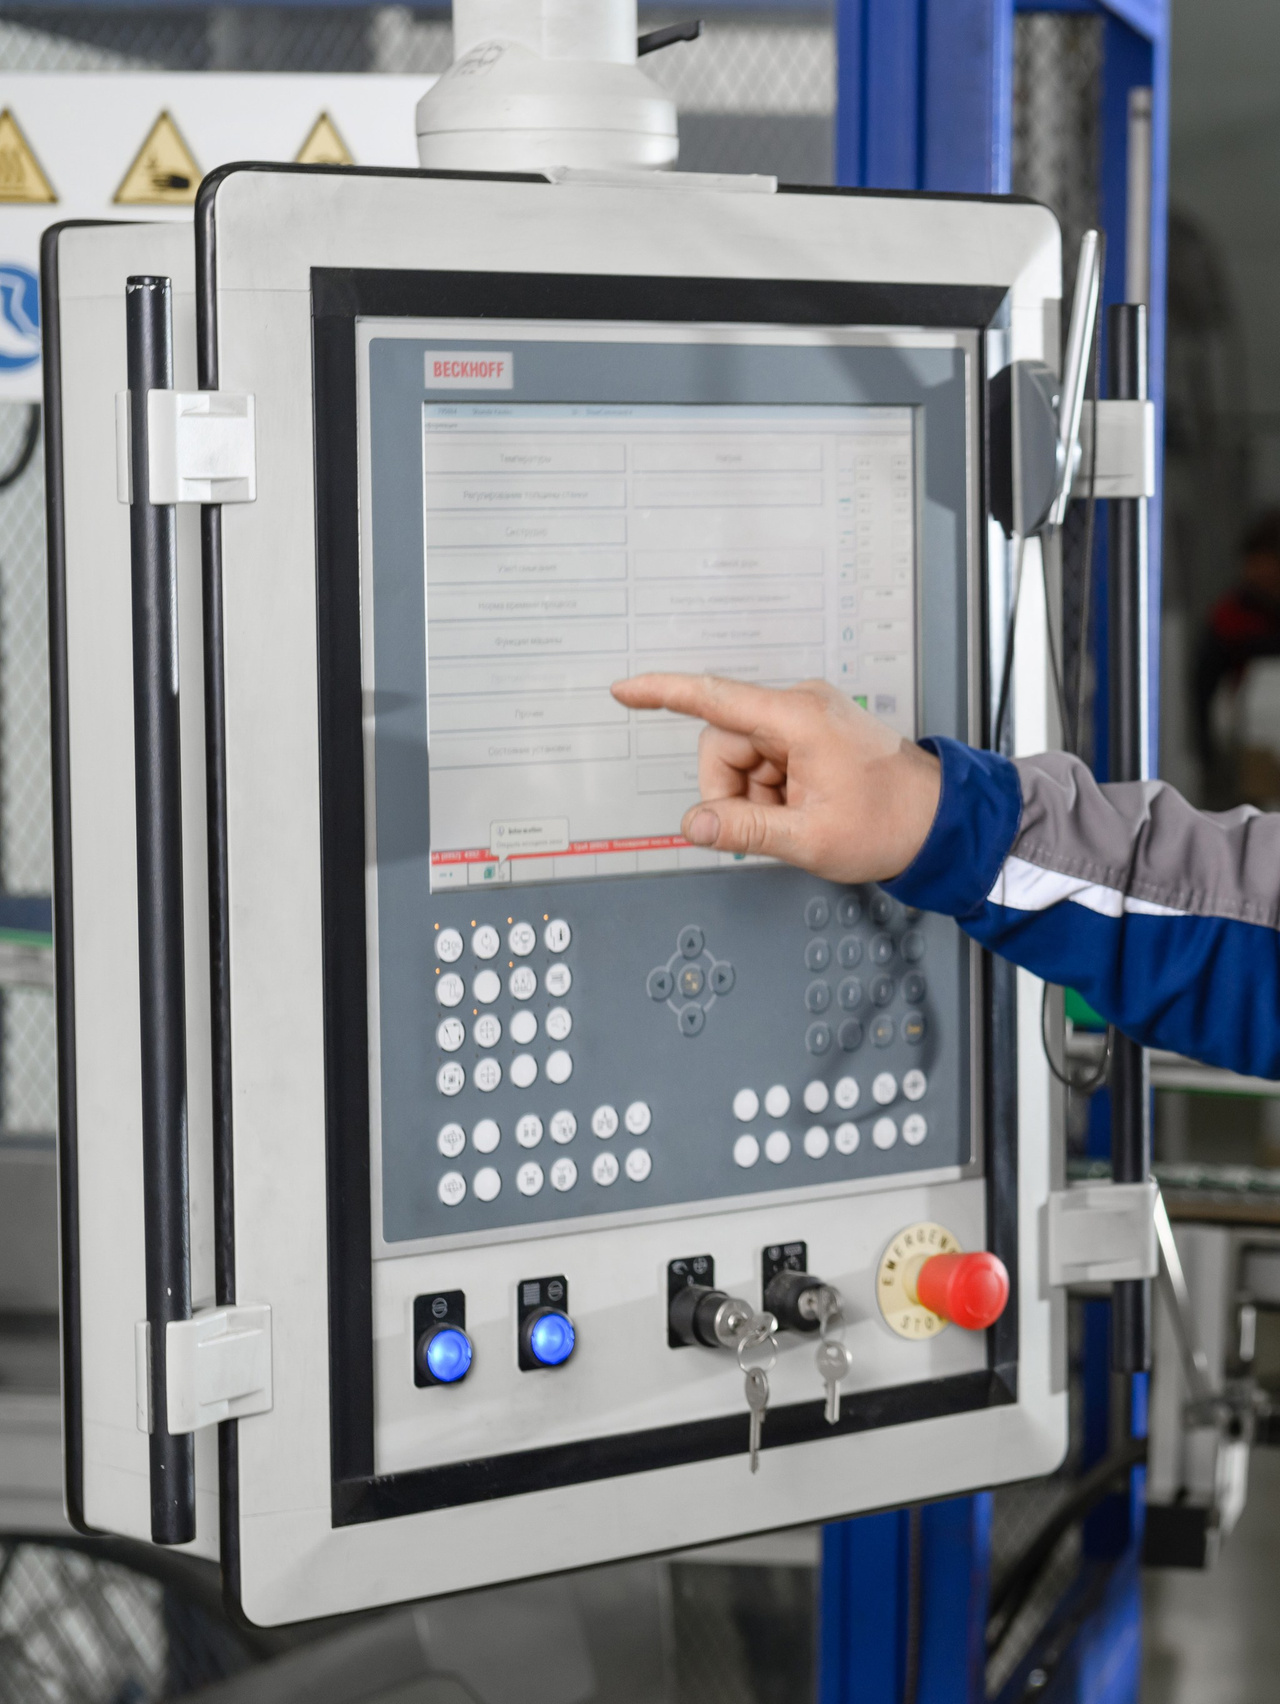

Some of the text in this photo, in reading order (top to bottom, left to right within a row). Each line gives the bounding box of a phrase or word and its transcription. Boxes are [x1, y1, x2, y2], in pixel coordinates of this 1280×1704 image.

[433, 361, 504, 378] BECKHOFF
[881, 1228, 958, 1287] EMERGEN
[901, 1314, 944, 1332] STO
